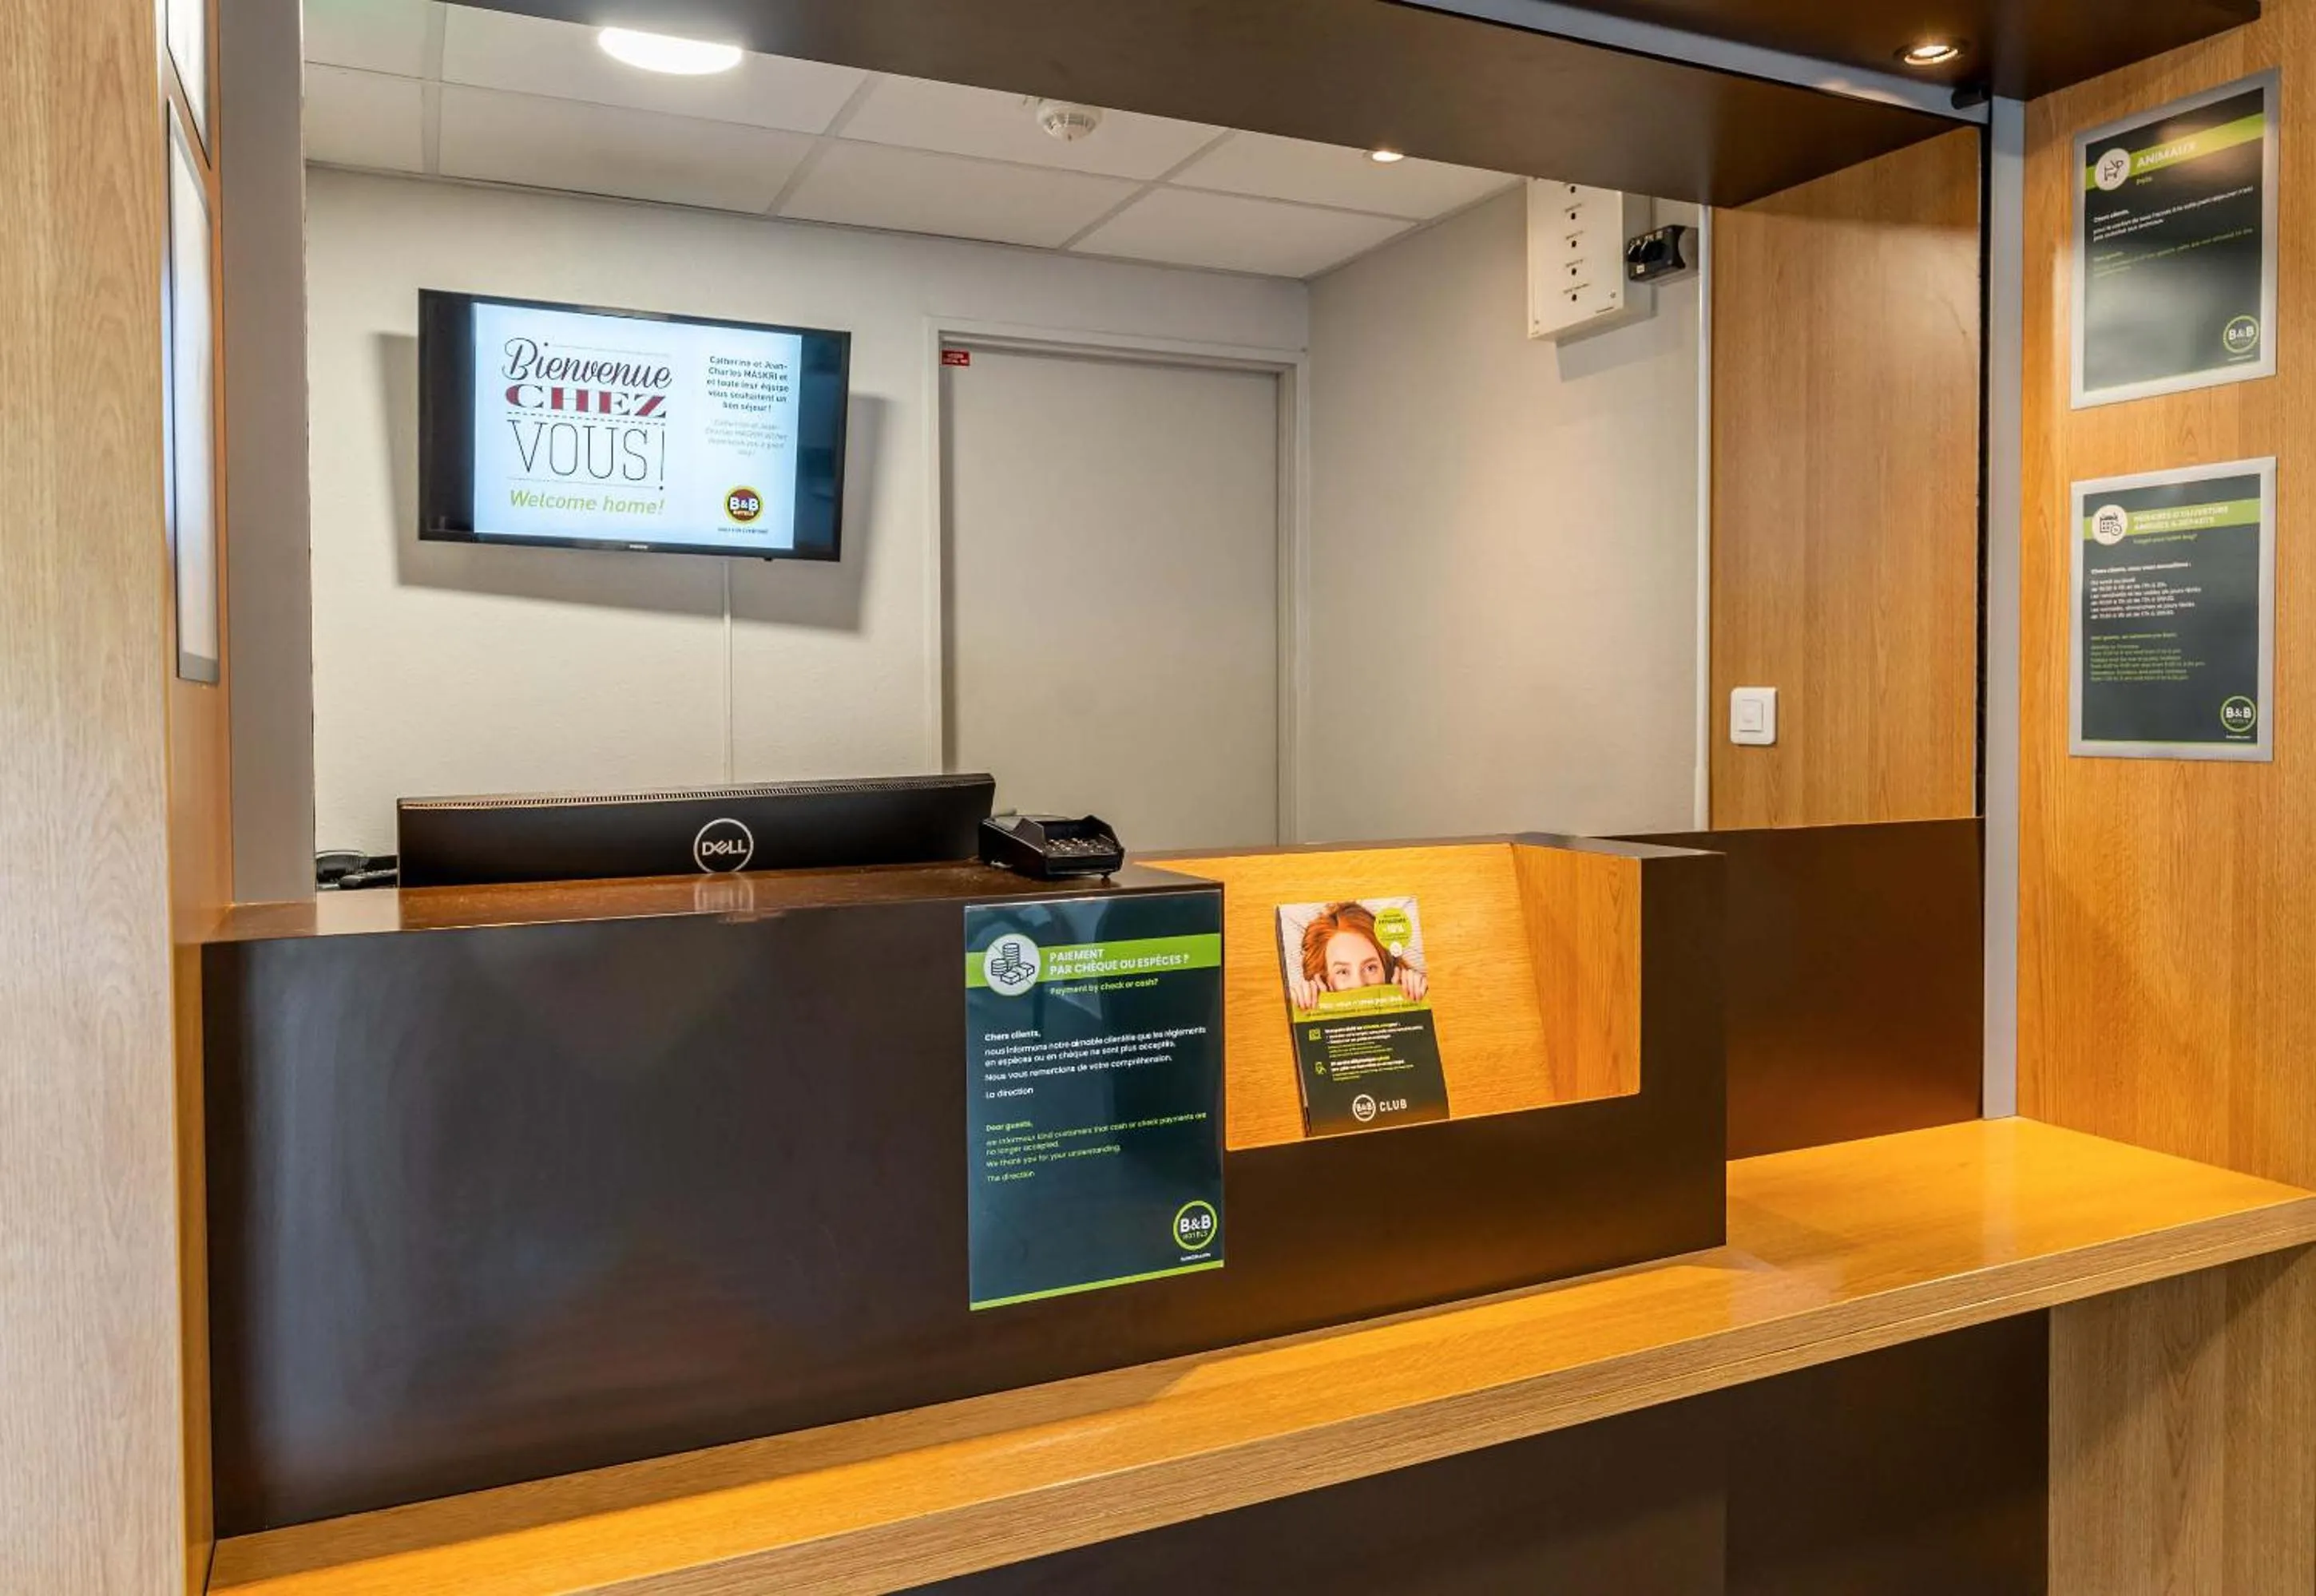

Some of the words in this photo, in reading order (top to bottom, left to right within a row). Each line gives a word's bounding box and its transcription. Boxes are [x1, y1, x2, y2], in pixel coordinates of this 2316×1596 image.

[2137, 141, 2196, 168] ANIMAUX
[2229, 326, 2254, 340] B&B
[502, 338, 672, 389] Bienvenue
[506, 384, 666, 418] CHEZ
[510, 489, 597, 513] Welcome
[603, 491, 664, 516] home!
[729, 497, 759, 511] B&B
[2226, 707, 2252, 719] B&B
[702, 839, 748, 856] DELL
[1049, 948, 1104, 962] PAIEMENT
[1050, 964, 1073, 975] PAR
[1074, 958, 1117, 973] CHÈQUE
[1120, 958, 1136, 968] OU
[1138, 953, 1182, 968] ESPÈCES
[1050, 984, 1087, 996] Payment
[1088, 983, 1098, 993] by
[1100, 980, 1124, 990] check
[1135, 978, 1158, 987] cash?
[1006, 1044, 1047, 1054] informons
[1048, 1040, 1070, 1050] notre
[1071, 1037, 1102, 1047] aimable
[1136, 1033, 1152, 1042] que
[997, 1056, 1032, 1067] espèces
[1120, 1044, 1136, 1054] plus
[1029, 1066, 1076, 1076] remercions
[997, 1087, 1033, 1098] direction
[1380, 1099, 1407, 1111] CLUB
[1180, 1214, 1212, 1233] B&B
